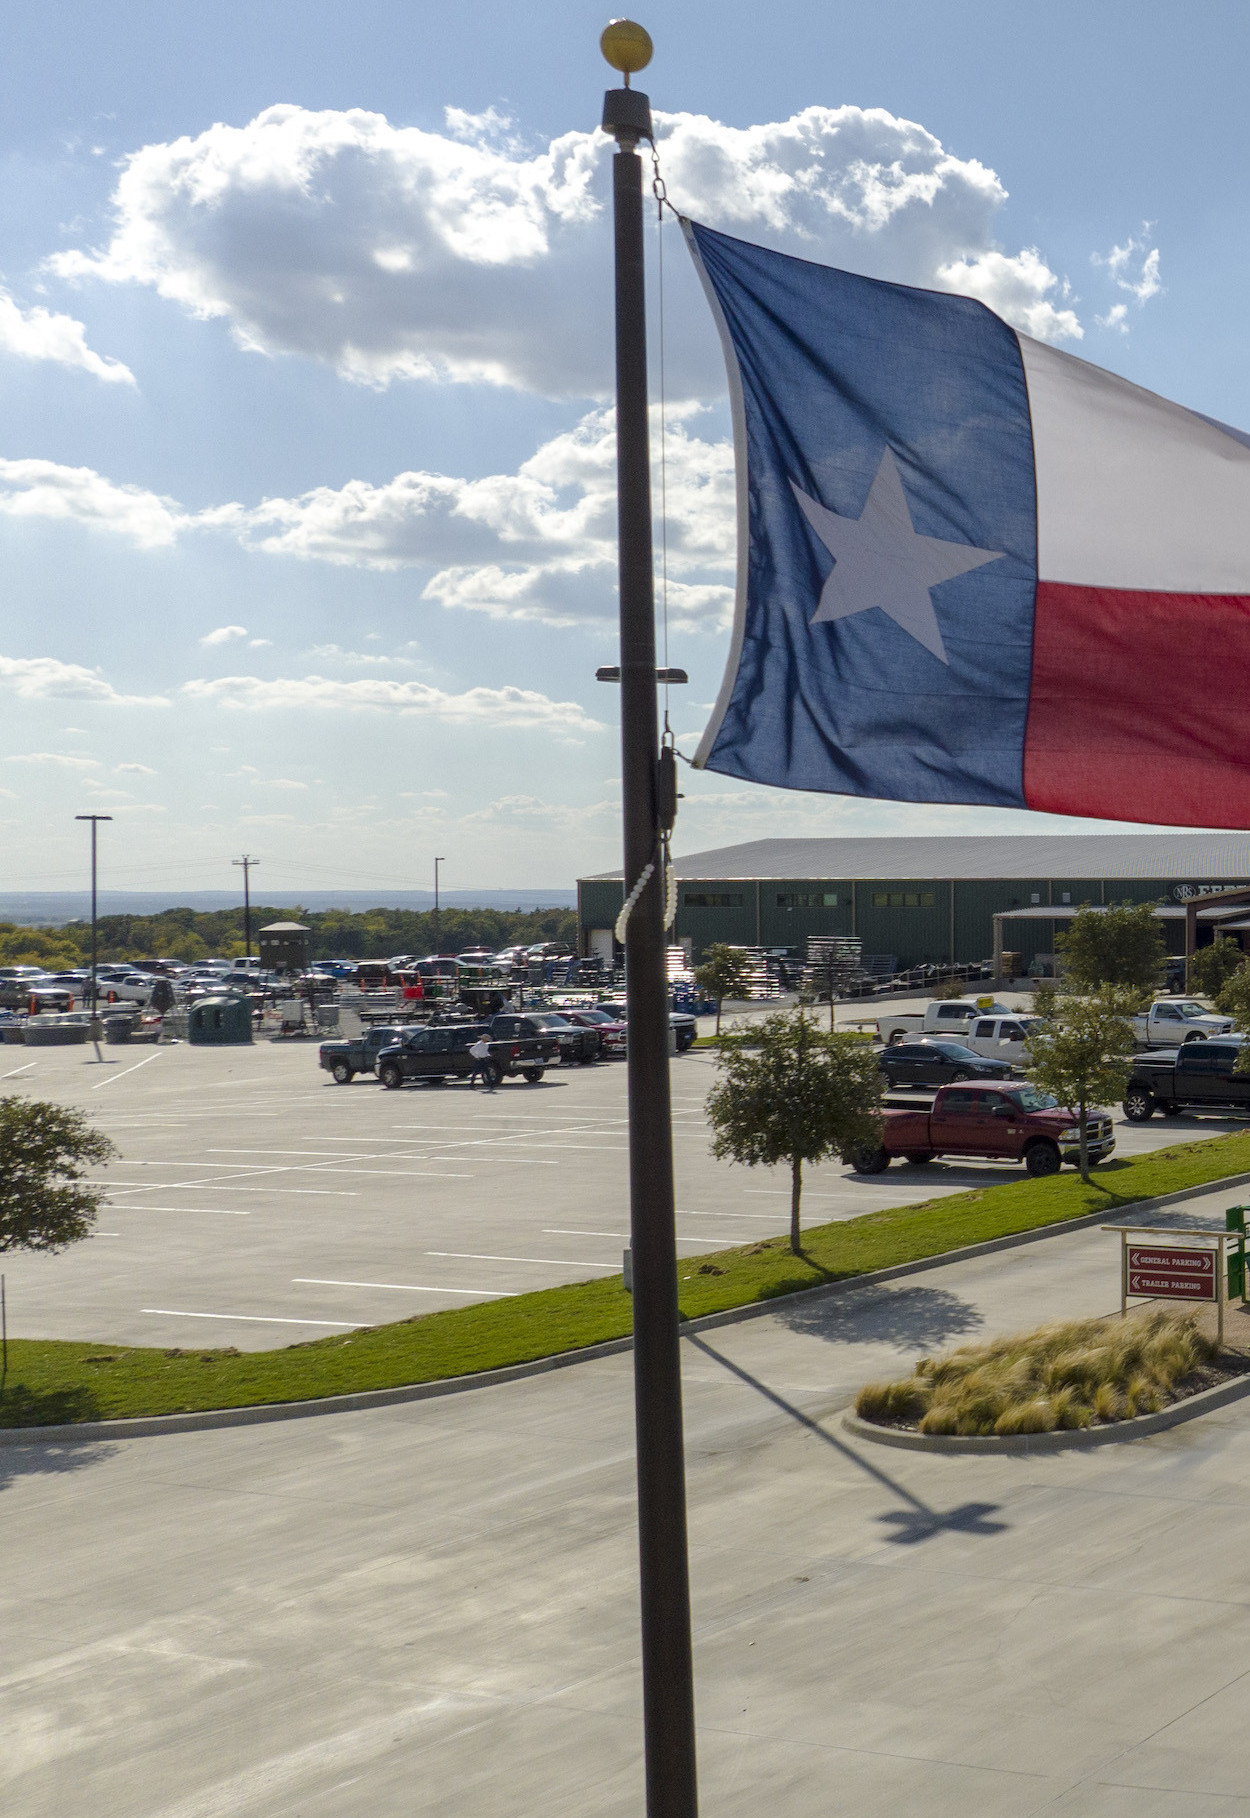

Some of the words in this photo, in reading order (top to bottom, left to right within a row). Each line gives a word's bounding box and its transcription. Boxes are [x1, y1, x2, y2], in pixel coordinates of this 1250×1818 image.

[1140, 1256, 1170, 1265] GENERAL
[1172, 1258, 1202, 1267] PARKING
[1141, 1279, 1169, 1288] TRAILER
[1171, 1281, 1201, 1290] PARKING
